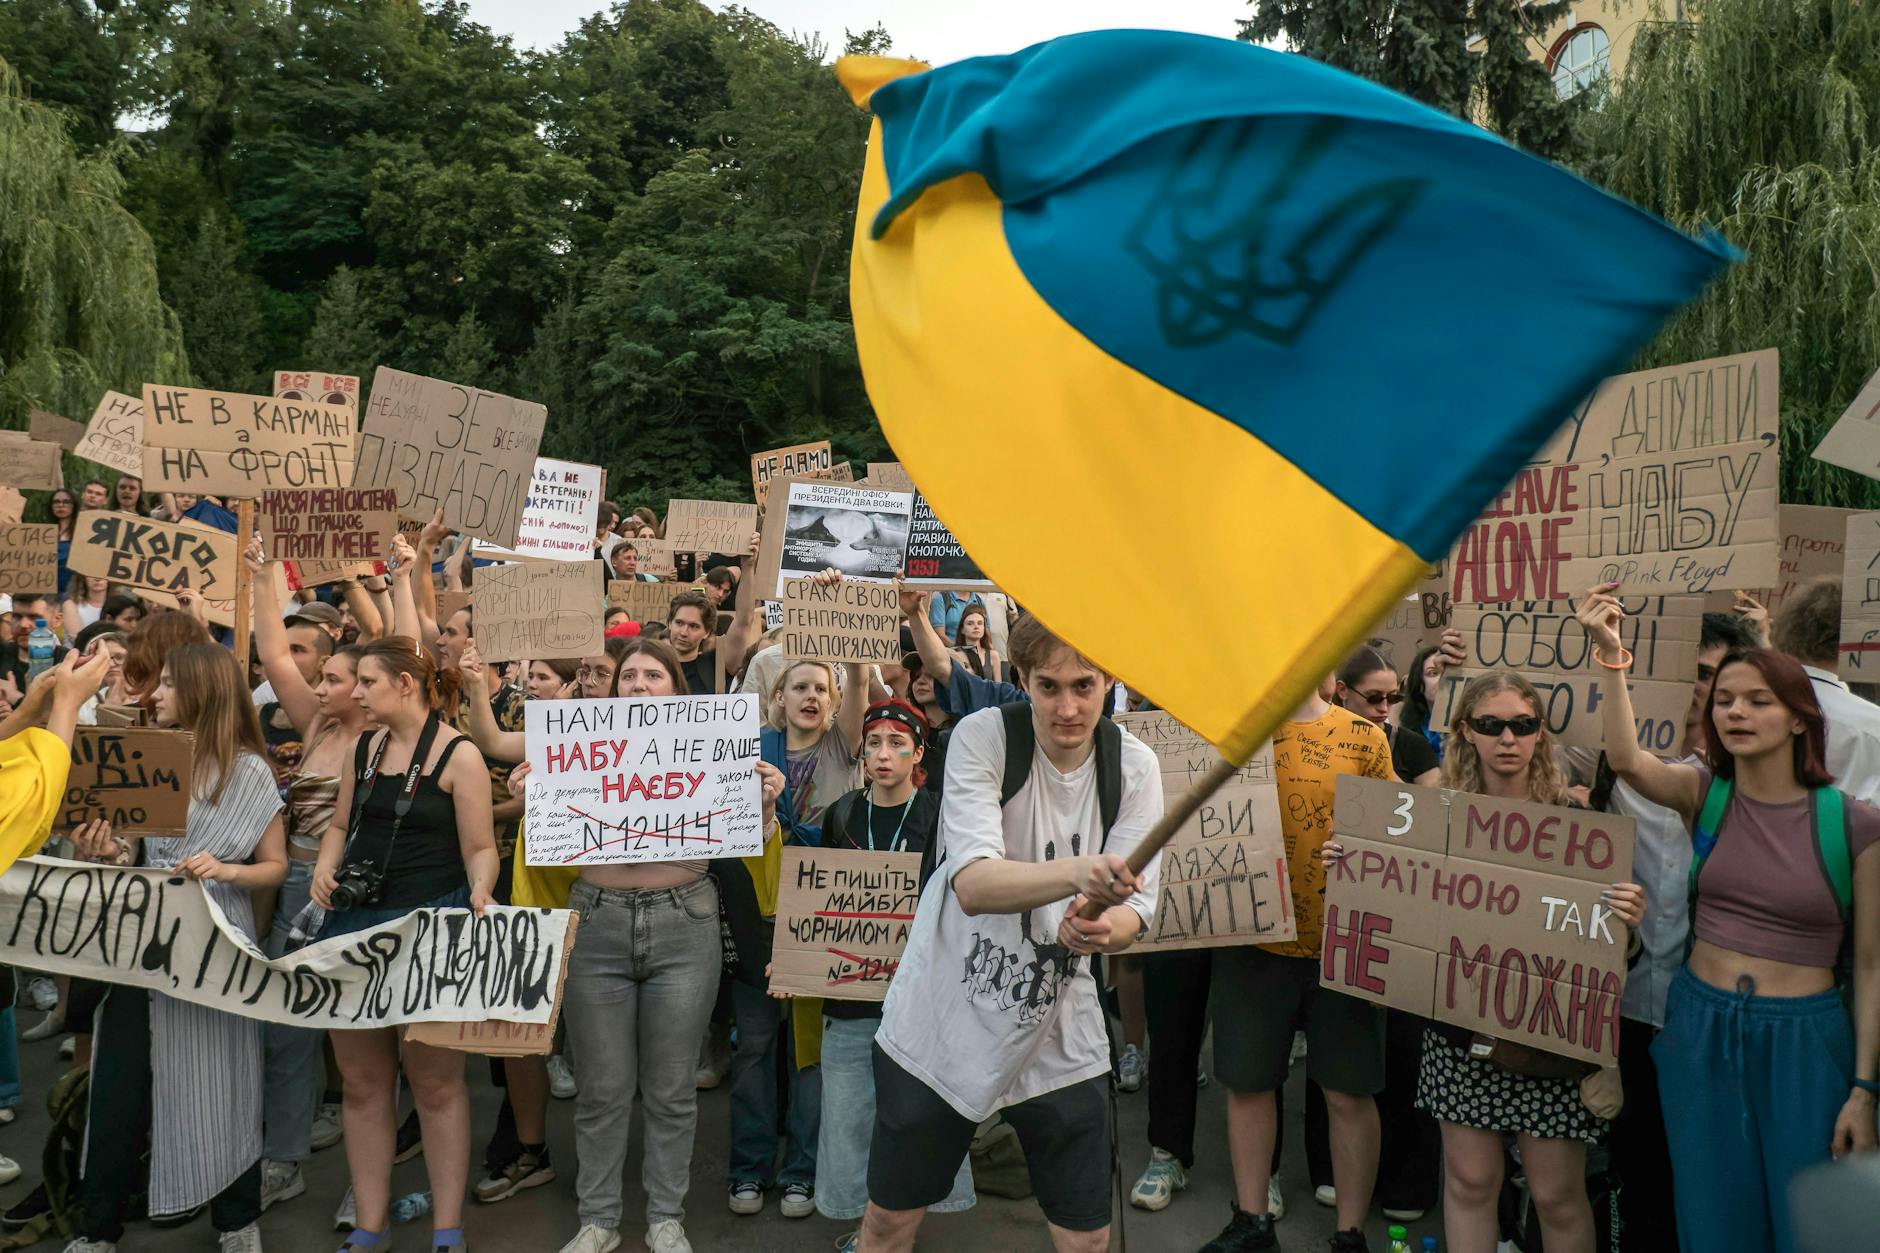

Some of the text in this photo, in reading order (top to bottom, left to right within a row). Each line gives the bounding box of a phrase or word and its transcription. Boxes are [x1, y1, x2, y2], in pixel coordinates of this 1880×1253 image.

[152, 390, 350, 438] НЕ В КАРМАН
[436, 386, 496, 456] ЗЕ
[161, 447, 208, 483] НА
[228, 441, 350, 488] ФРОНТ
[564, 471, 579, 483] НЕ
[757, 457, 778, 482] НЕ
[783, 449, 829, 476] ДАМО
[262, 490, 308, 515] НАХУЯ
[310, 489, 345, 514] МЕНІ
[794, 492, 905, 509] ПРЕЗИДЕНТА ДВА ВОВКИ:
[812, 486, 890, 499] ВСЕРЕДИНІ ОФІСУ
[1480, 465, 1580, 520] EAVE
[1588, 452, 1761, 560] НАБУ
[273, 514, 364, 534] ЩО ПРАЦЮЄ
[686, 517, 738, 532] ПРОТИ
[88, 516, 217, 569] ЯКОГО
[273, 534, 325, 558] ПРОТИ
[332, 531, 381, 558] МЕНЕ
[908, 545, 967, 558] КНОПОЧКУ
[908, 559, 940, 577] 13531
[1453, 517, 1573, 603] ALONE
[1668, 552, 1735, 592] Floyd
[786, 579, 899, 611] СРАКУ СВОЮ
[788, 607, 897, 633] ГЕНПРОКУРОРУ
[786, 632, 901, 658] ПІДПОРЯДКУЙ
[547, 699, 748, 734] НАМ ПОТРІБНО
[640, 738, 660, 765] А
[673, 738, 705, 763] НЕ
[712, 738, 761, 762] ВАШЕ
[404, 763, 421, 793] Canon
[603, 769, 753, 803] НАЄБУ ЗАКОН
[1200, 799, 1254, 838] ВИ
[1465, 804, 1614, 869] МОЄЮ
[834, 864, 916, 890] ПИШІТЬ
[1336, 850, 1614, 945] КРАЇНОЮ ТАК
[788, 917, 892, 945] ЧОРНИЛОМ
[1324, 904, 1622, 1057] НЕ МОЖНА
